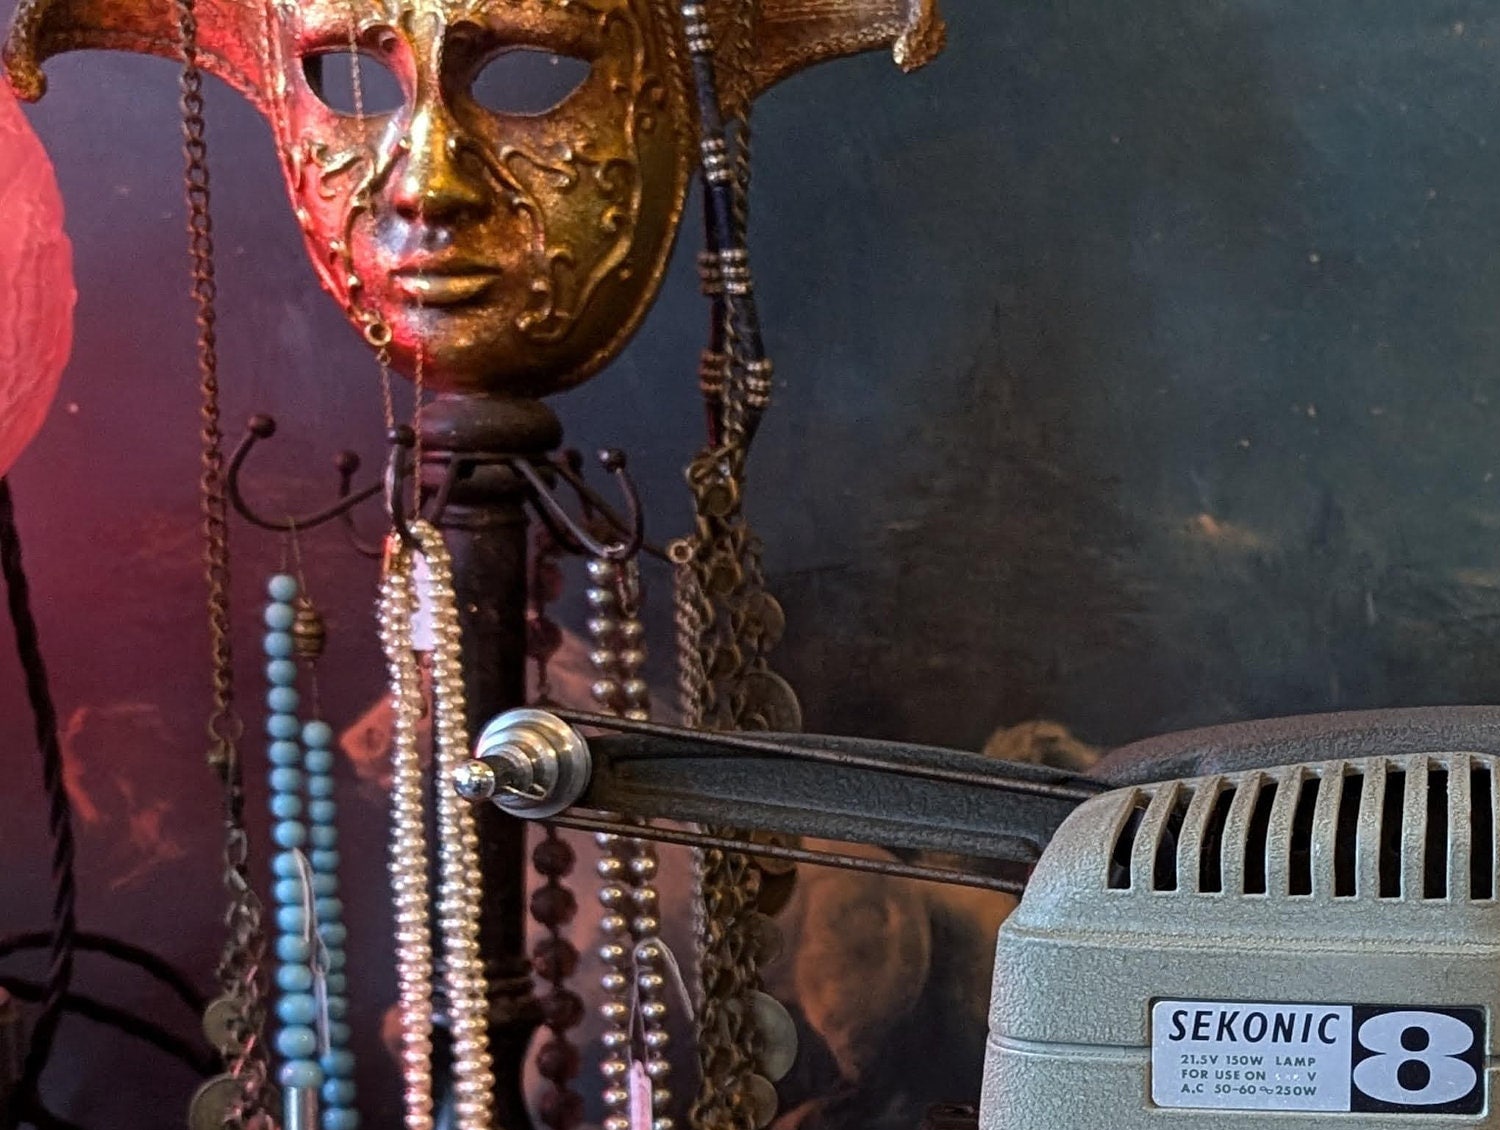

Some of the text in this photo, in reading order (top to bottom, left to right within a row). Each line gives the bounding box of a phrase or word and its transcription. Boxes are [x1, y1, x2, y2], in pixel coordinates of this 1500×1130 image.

[1168, 1009, 1341, 1045] SEKONIC
[1180, 1054, 1317, 1067] 21.5V 150W LAMP
[1352, 1010, 1478, 1106] 8
[1181, 1069, 1208, 1080] FOR
[1215, 1070, 1241, 1081] USE
[1244, 1071, 1266, 1081] ON
[1307, 1071, 1317, 1082] V
